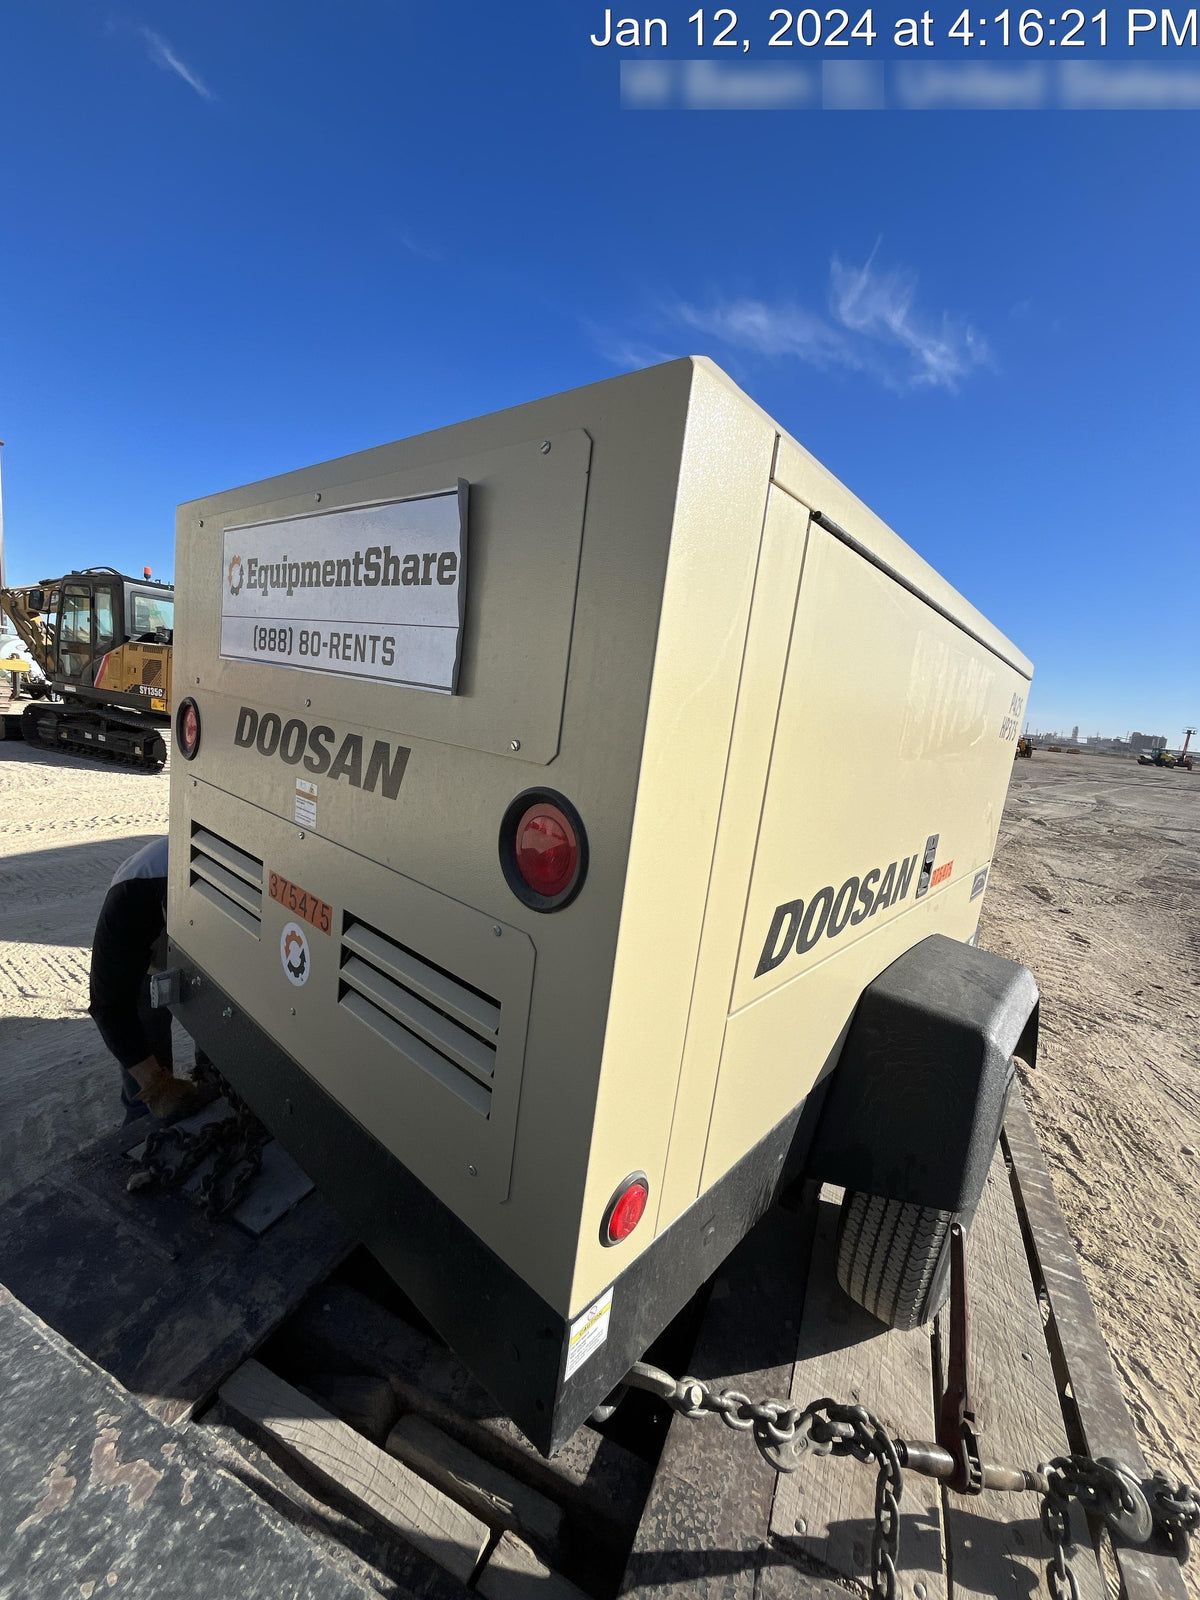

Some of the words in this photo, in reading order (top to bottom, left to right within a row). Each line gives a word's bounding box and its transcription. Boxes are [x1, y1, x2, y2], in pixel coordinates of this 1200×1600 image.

[246, 545, 458, 597] EquipmentShare
[253, 625, 294, 656] (888)
[299, 630, 396, 666] 80-RENTS
[139, 685, 163, 697] SY135C
[234, 706, 412, 801] DOOSAN
[269, 873, 331, 933] 375475
[753, 853, 919, 980] DOOSAN
